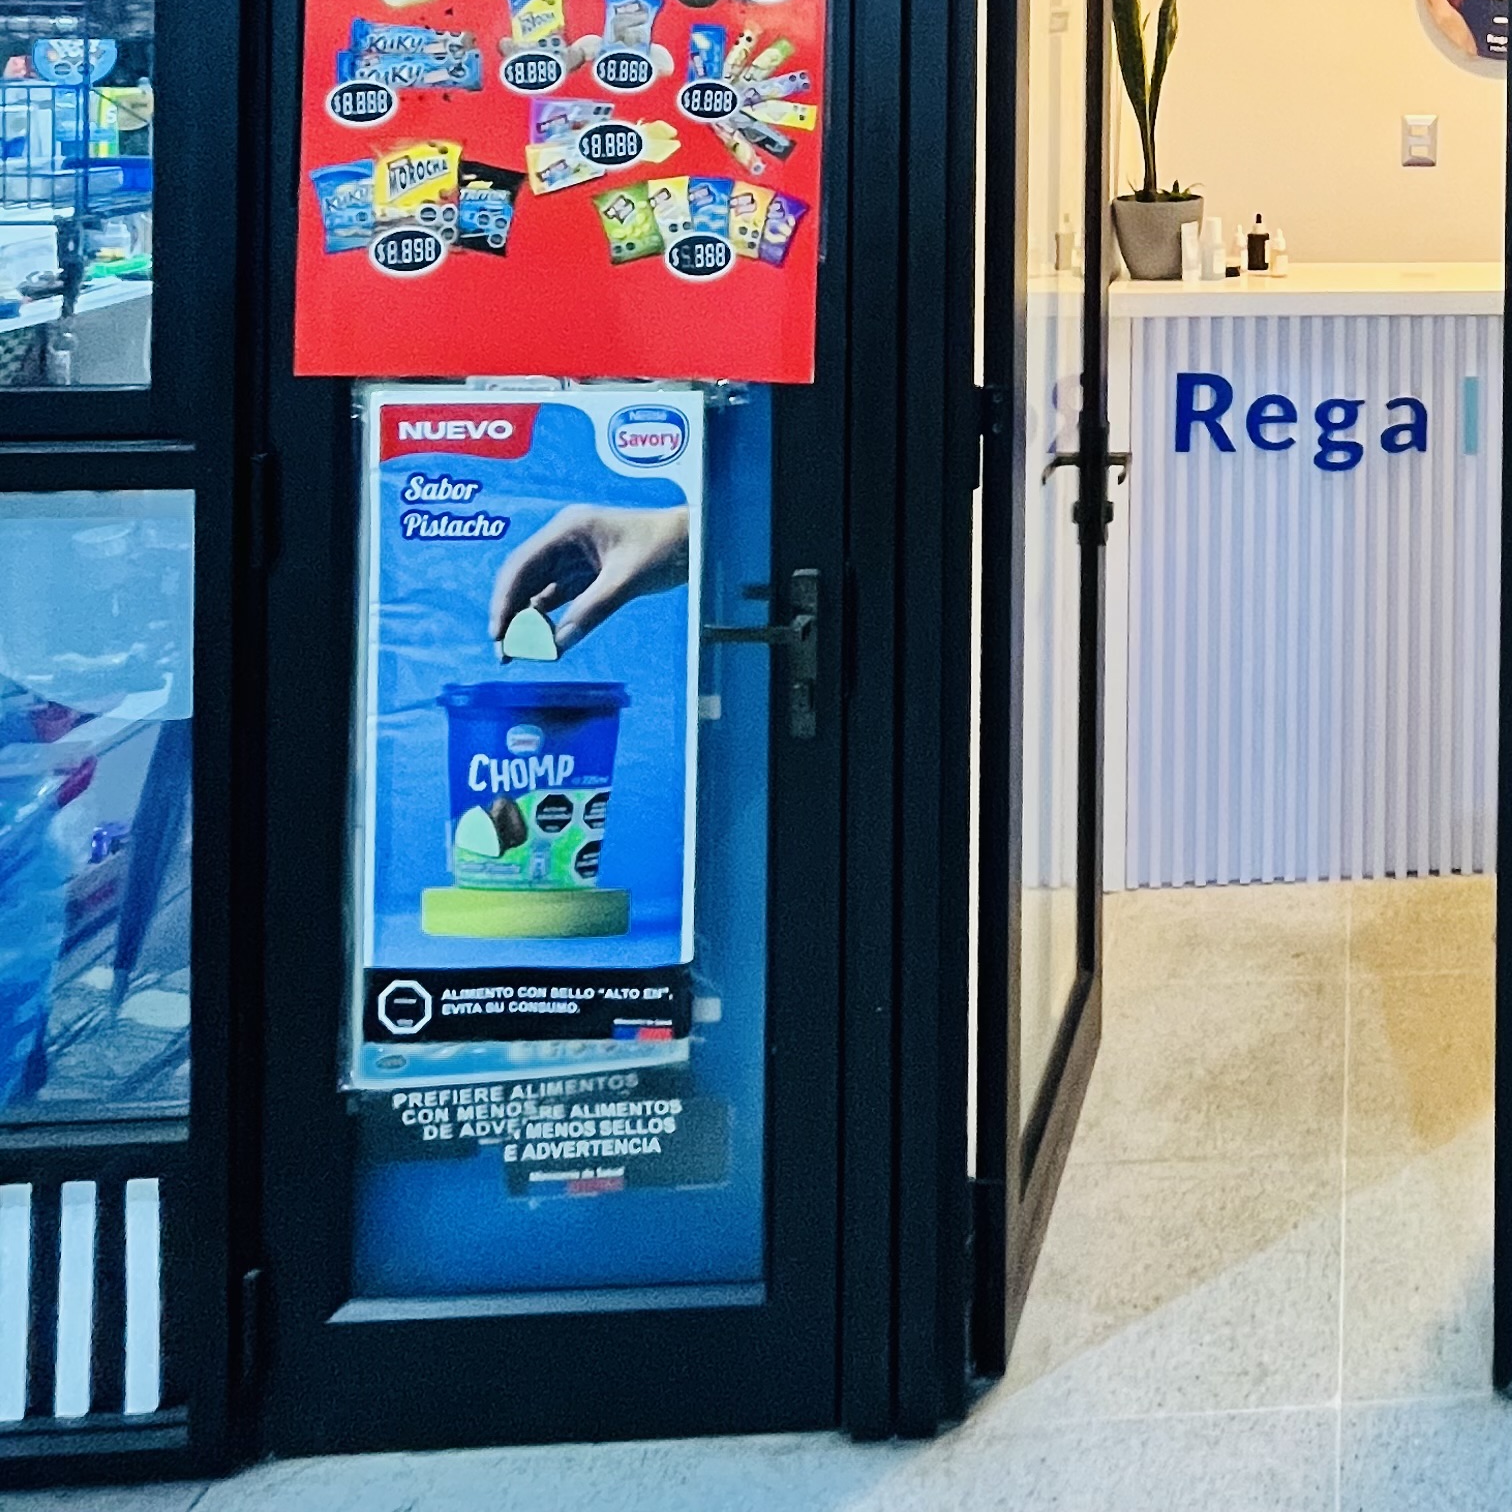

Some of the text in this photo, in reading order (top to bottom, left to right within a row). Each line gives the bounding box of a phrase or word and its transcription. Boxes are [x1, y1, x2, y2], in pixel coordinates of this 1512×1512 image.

[389, 158, 449, 198] MOROCHA
[398, 419, 514, 441] NUEVO
[618, 430, 680, 451] Savory
[404, 475, 479, 501] Sabor
[403, 512, 506, 537] Pistacho
[468, 753, 575, 793] CHOMP
[441, 987, 514, 1000] ALIMENTO
[517, 987, 547, 999] CON
[441, 1001, 482, 1015] EVITA
[391, 1072, 639, 1110] PREFIERE ALIMENTOS
[401, 1107, 449, 1126] CON
[569, 1098, 684, 1119] ALIMENTOS
[422, 1123, 454, 1141] DE
[525, 1115, 677, 1140] MENOS SELLOS
[520, 1136, 662, 1162] ADVERTENCIA
